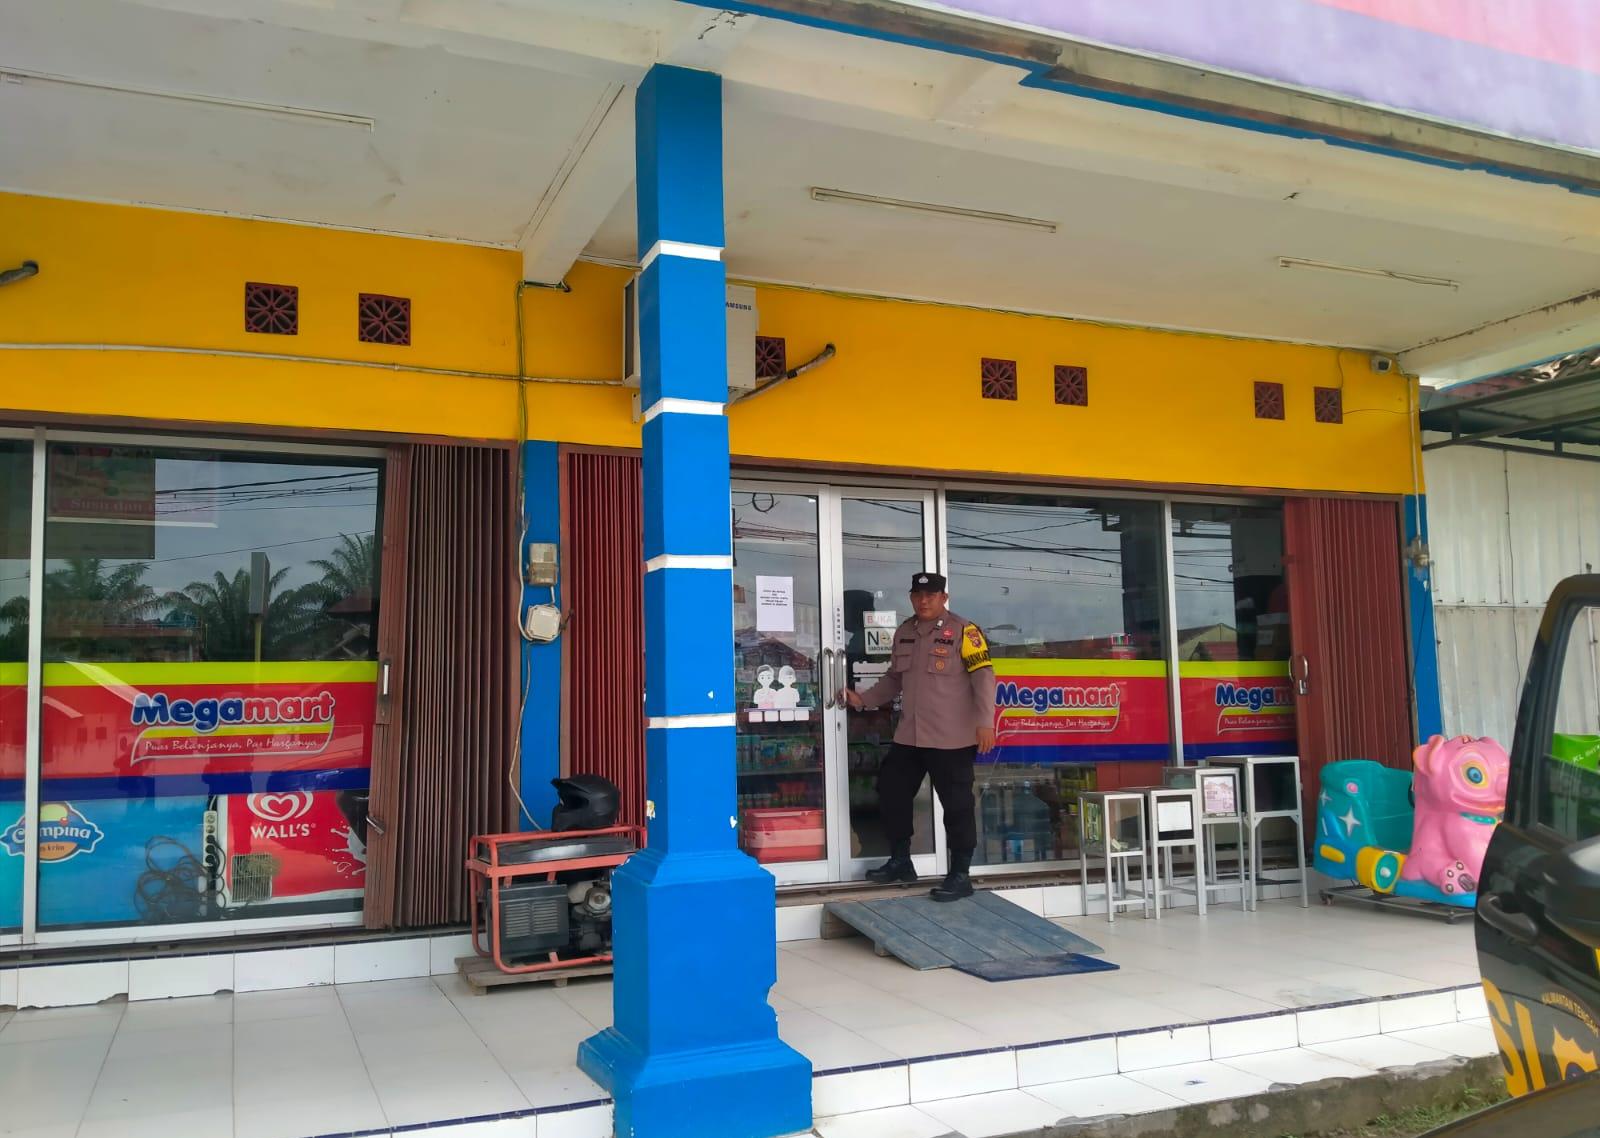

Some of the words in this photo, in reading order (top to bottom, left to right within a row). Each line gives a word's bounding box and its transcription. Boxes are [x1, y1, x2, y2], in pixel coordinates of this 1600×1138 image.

[725, 301, 752, 311] AMSUNG
[995, 681, 1120, 713] Megamart
[1214, 682, 1296, 712] Megam
[131, 691, 336, 733] Megamart
[12, 826, 92, 844] Cmpina
[250, 824, 310, 840] WALL'S
